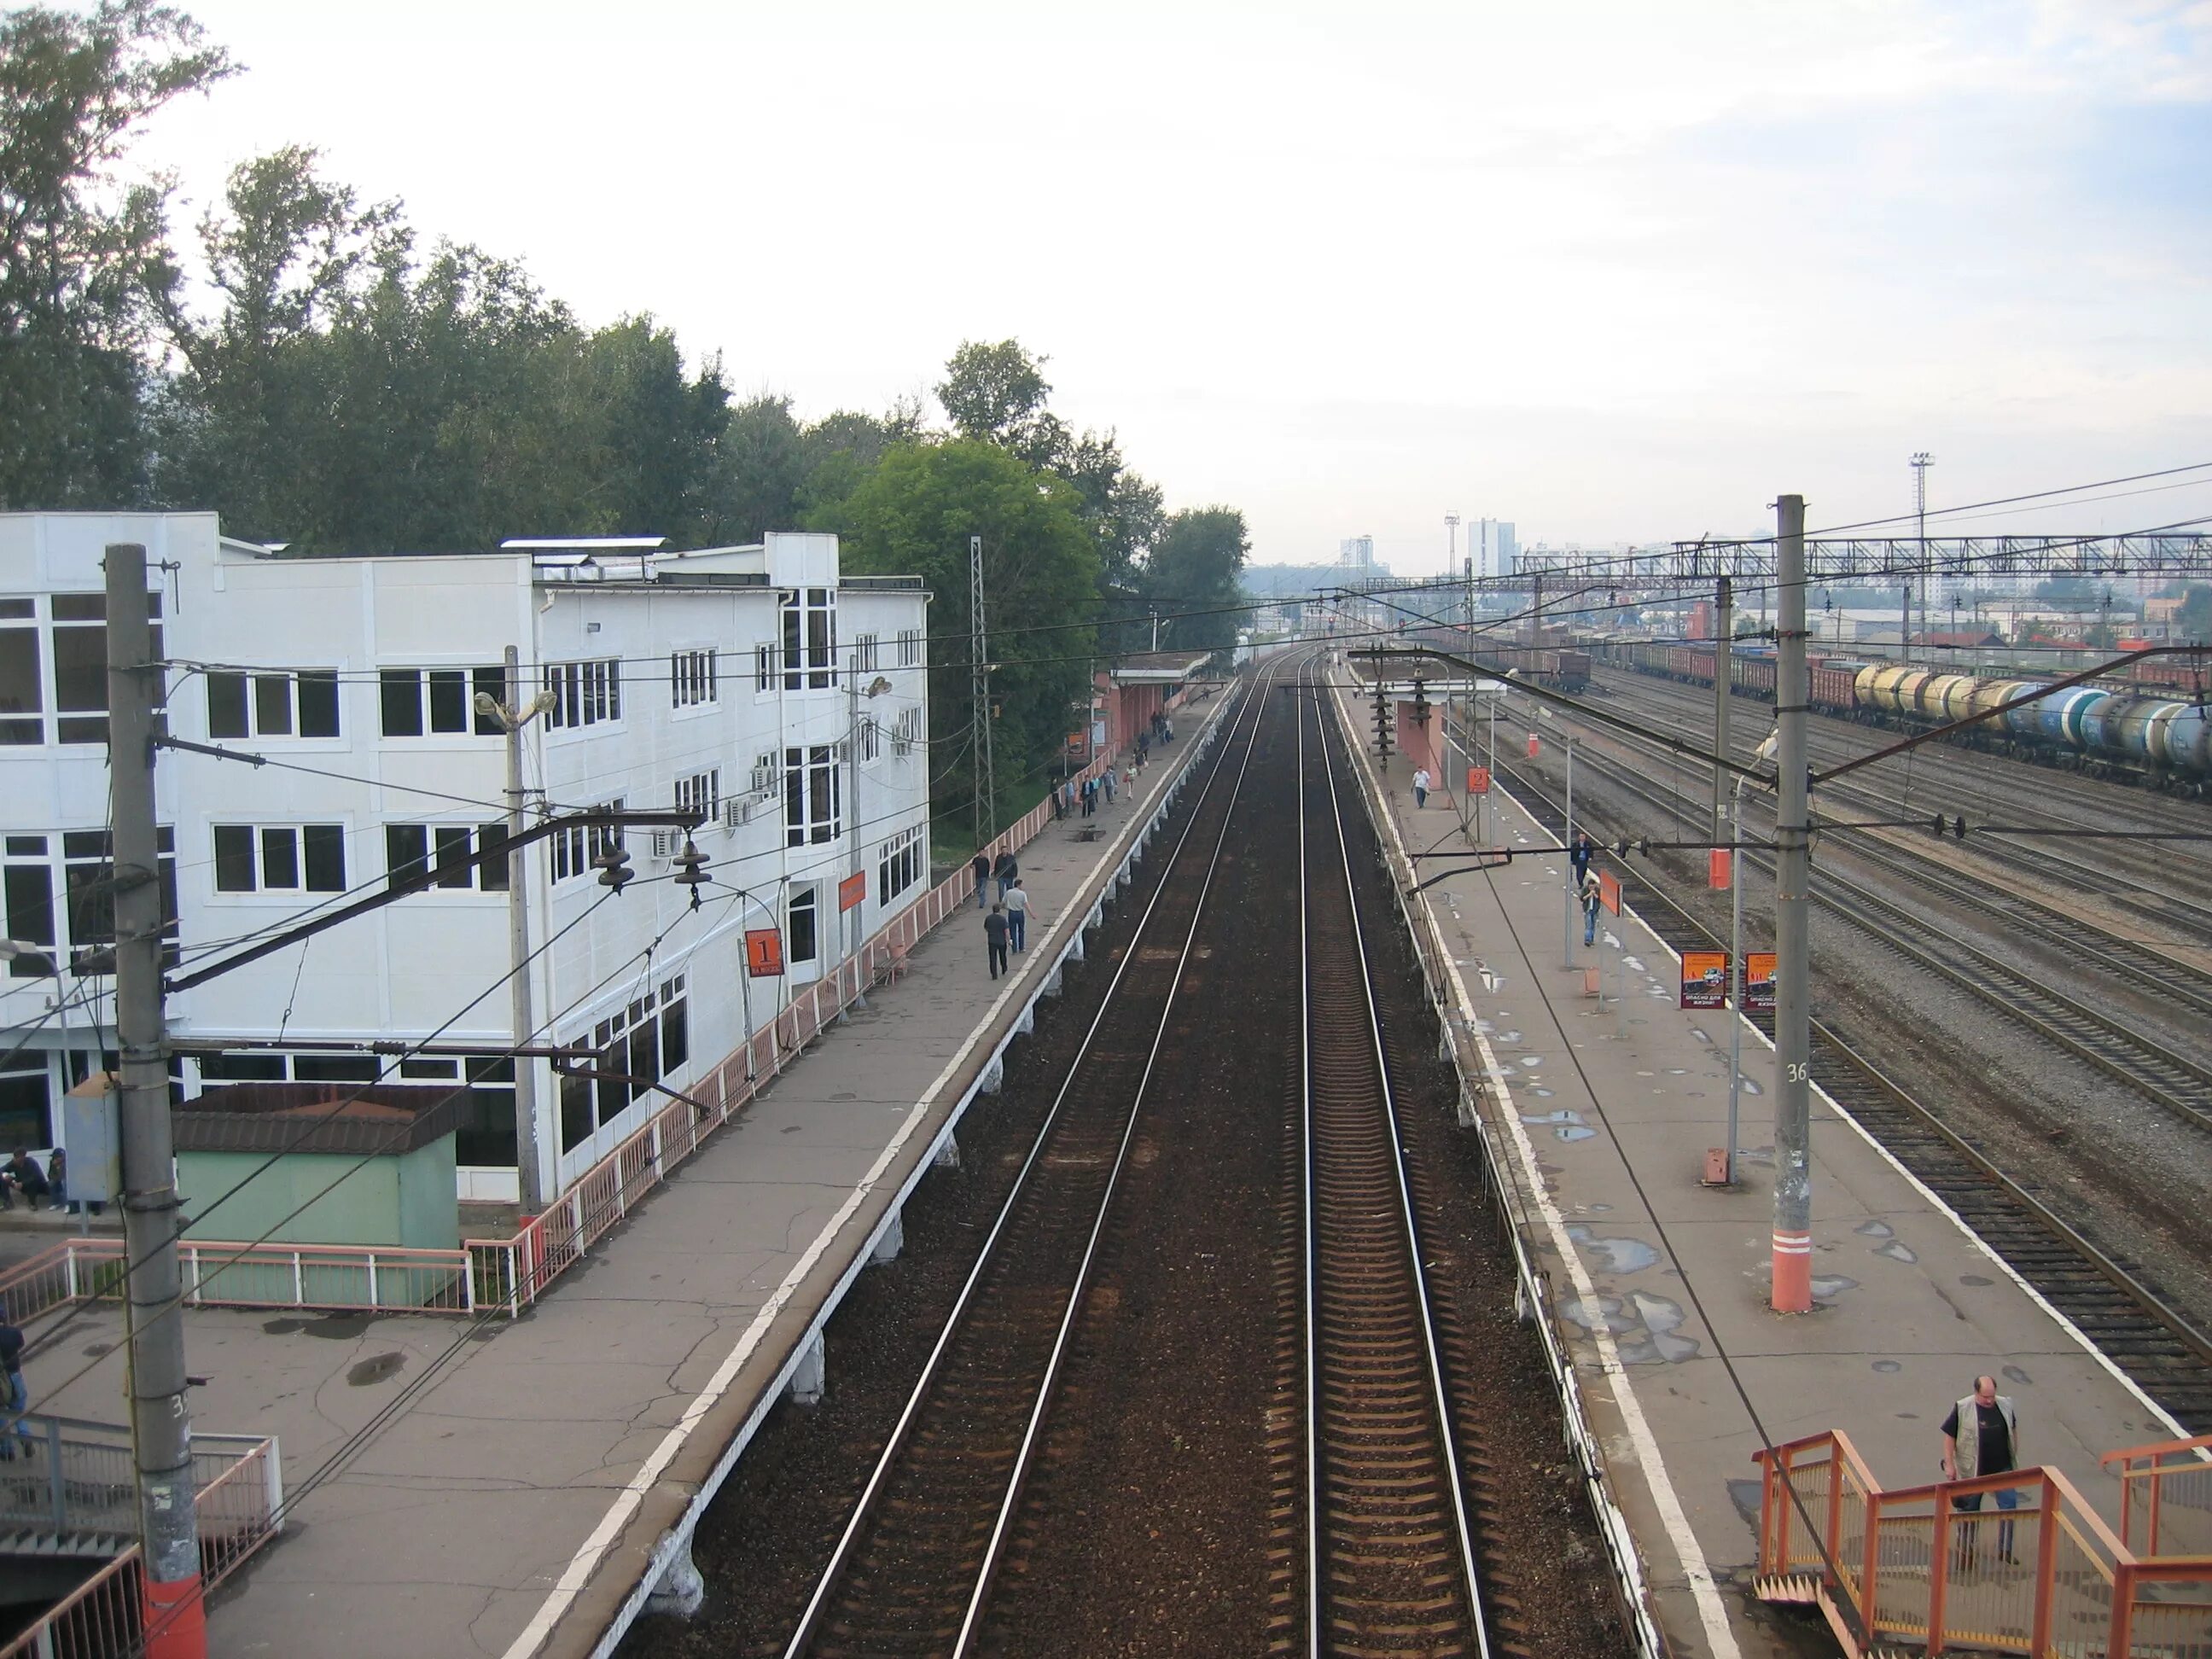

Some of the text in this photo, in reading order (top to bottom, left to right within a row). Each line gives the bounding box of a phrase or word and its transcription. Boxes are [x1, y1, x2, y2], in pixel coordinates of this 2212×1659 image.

[1474, 772, 1483, 786] 2
[757, 940, 772, 963] 1
[1787, 1062, 1807, 1083] 36
